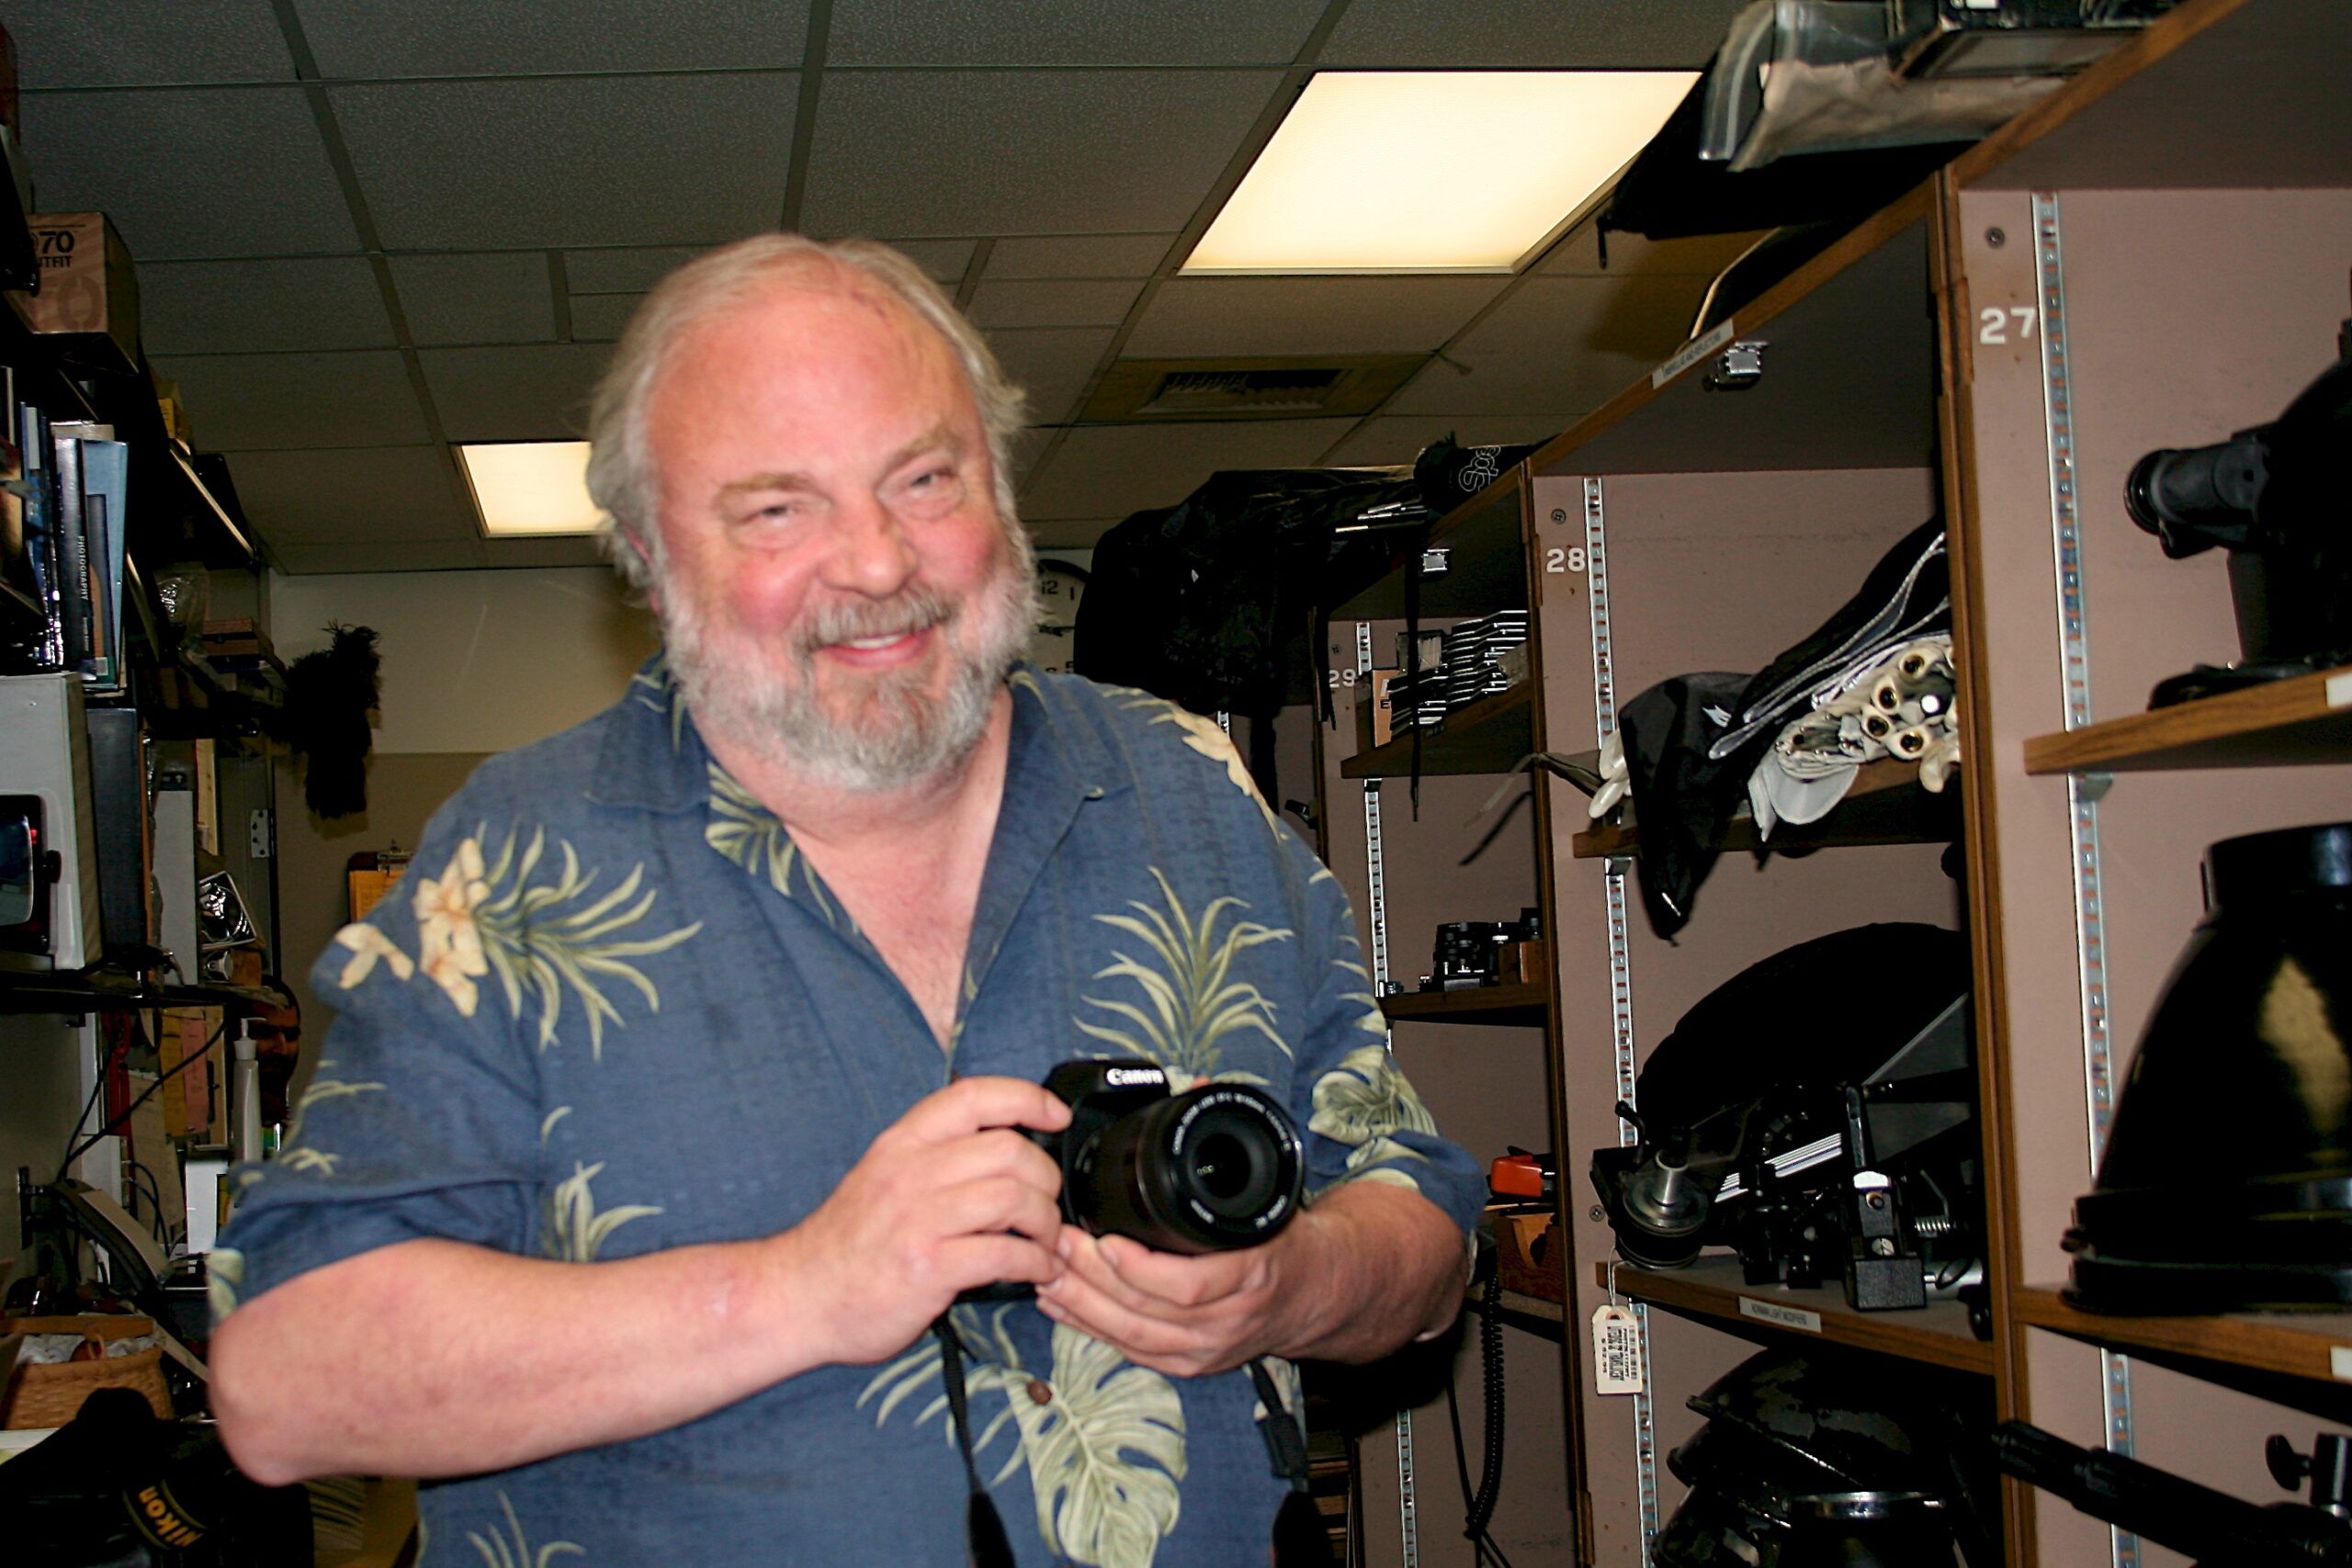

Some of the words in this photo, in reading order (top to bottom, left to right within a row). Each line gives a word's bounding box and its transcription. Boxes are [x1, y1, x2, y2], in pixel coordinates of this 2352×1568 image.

[33, 231, 75, 254] 70
[1980, 307, 2035, 344] 27
[78, 536, 88, 601] PHOTOGRAPHY
[1546, 547, 1586, 573] 28
[1042, 581, 1058, 595] 12
[1329, 669, 1356, 688] 29
[1106, 1068, 1164, 1085] Canon
[139, 1485, 203, 1547] Nikon
